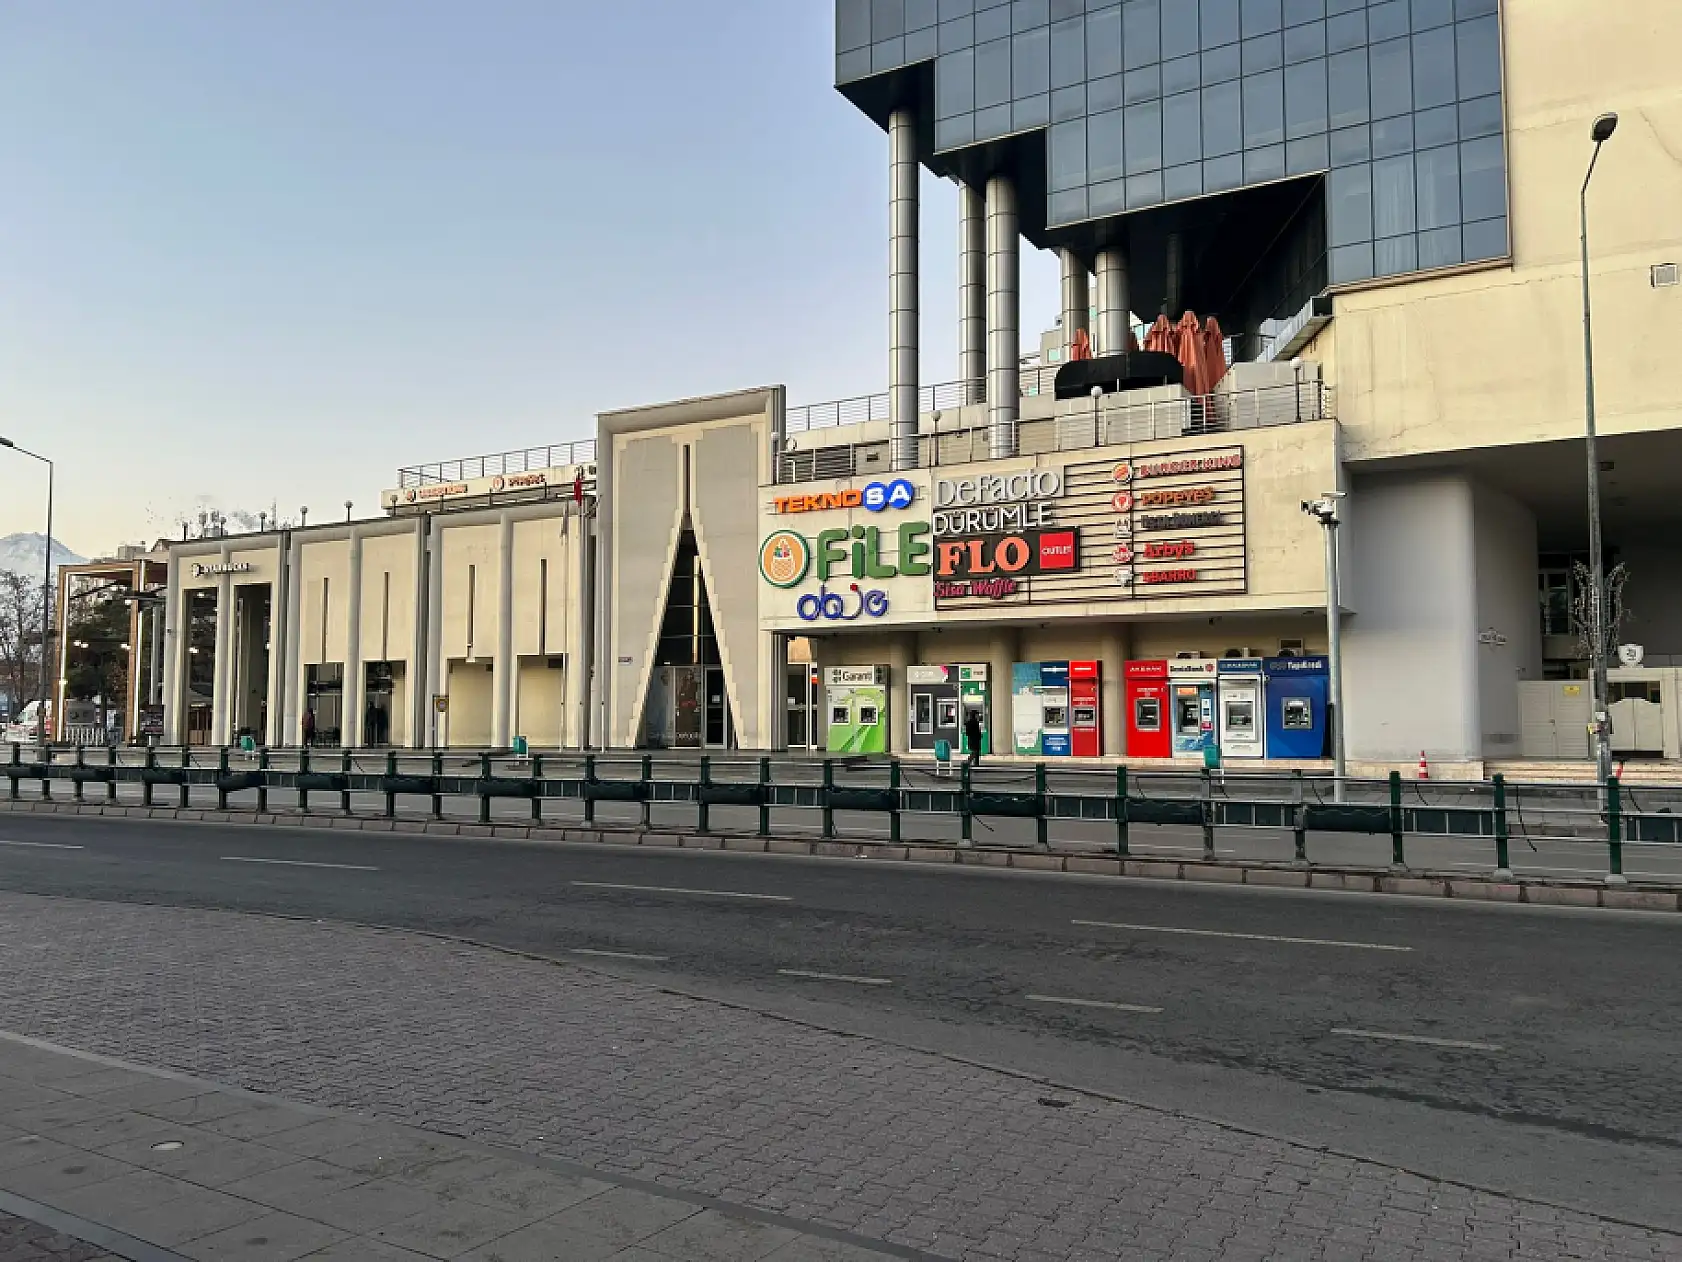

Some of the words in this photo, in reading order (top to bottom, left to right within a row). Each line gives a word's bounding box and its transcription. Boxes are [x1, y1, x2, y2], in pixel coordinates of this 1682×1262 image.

[774, 478, 915, 513] TEKNOSA
[936, 468, 1060, 507] DeFacto
[937, 536, 1030, 576] FLO
